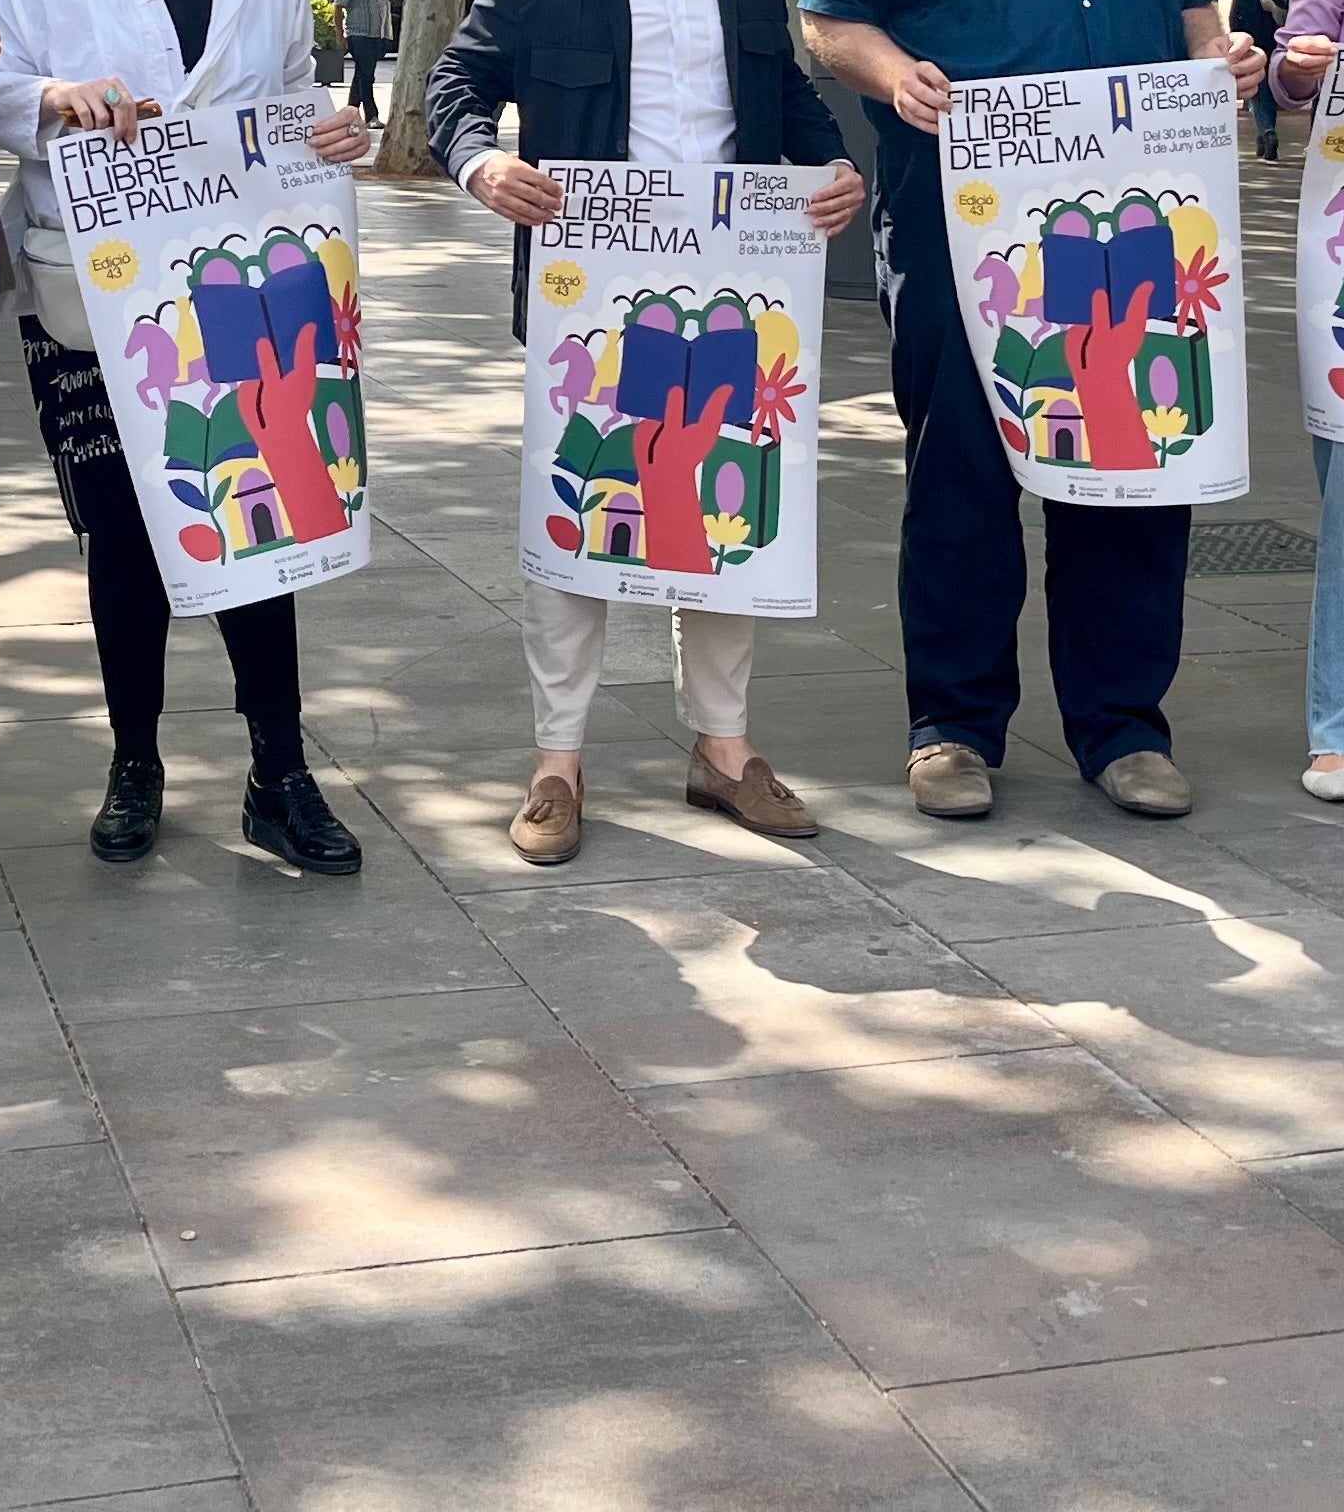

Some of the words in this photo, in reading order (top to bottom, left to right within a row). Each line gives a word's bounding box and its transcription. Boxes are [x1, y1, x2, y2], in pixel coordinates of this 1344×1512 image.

[1138, 72, 1189, 93] Plaça
[949, 85, 1015, 115] FIRA
[1023, 80, 1081, 110] DEL
[1141, 88, 1229, 113] d'Espanya
[266, 103, 315, 126] Plaça
[267, 123, 315, 145] d'Esp
[948, 110, 1052, 143] LLIBRE
[1143, 129, 1161, 142] Del
[1162, 129, 1176, 141] 30
[1178, 128, 1190, 139] de
[1192, 125, 1217, 140] Maig
[1218, 124, 1226, 135] al
[58, 136, 135, 173] FIRA
[140, 119, 208, 154] DEL
[950, 142, 992, 171] DE
[999, 133, 1105, 168] PALMA
[1143, 144, 1151, 154] 8
[1152, 142, 1167, 154] de
[1168, 141, 1193, 156] Juny
[1195, 138, 1209, 150] de
[1210, 135, 1233, 148] 2025
[64, 153, 180, 203] LLIBRE
[276, 161, 293, 176] Del
[292, 161, 305, 173] 30
[305, 159, 317, 170] de
[289, 176, 302, 187] de
[303, 174, 324, 184] Juny
[324, 169, 336, 180] de
[548, 168, 616, 195] FIRA
[626, 170, 685, 197] DEL
[743, 171, 788, 194] Plaça
[71, 196, 123, 233] DE
[126, 173, 239, 221] PALMA
[554, 196, 653, 224] LIBRE
[959, 194, 994, 207] Edició
[969, 205, 984, 216] 43
[541, 221, 585, 248] DE
[591, 223, 701, 254] PALMA
[739, 230, 754, 241] Del
[756, 230, 768, 241] 30
[770, 229, 782, 241] de
[783, 230, 806, 244] Maig
[807, 229, 816, 240] al
[738, 243, 745, 255] 8
[747, 243, 759, 255] de
[761, 243, 783, 257] Juny
[785, 243, 797, 254] de
[798, 242, 822, 255] 2025
[92, 253, 132, 272] Edició
[106, 268, 122, 280] 43
[545, 272, 581, 288] Edició
[554, 285, 569, 297] 43
